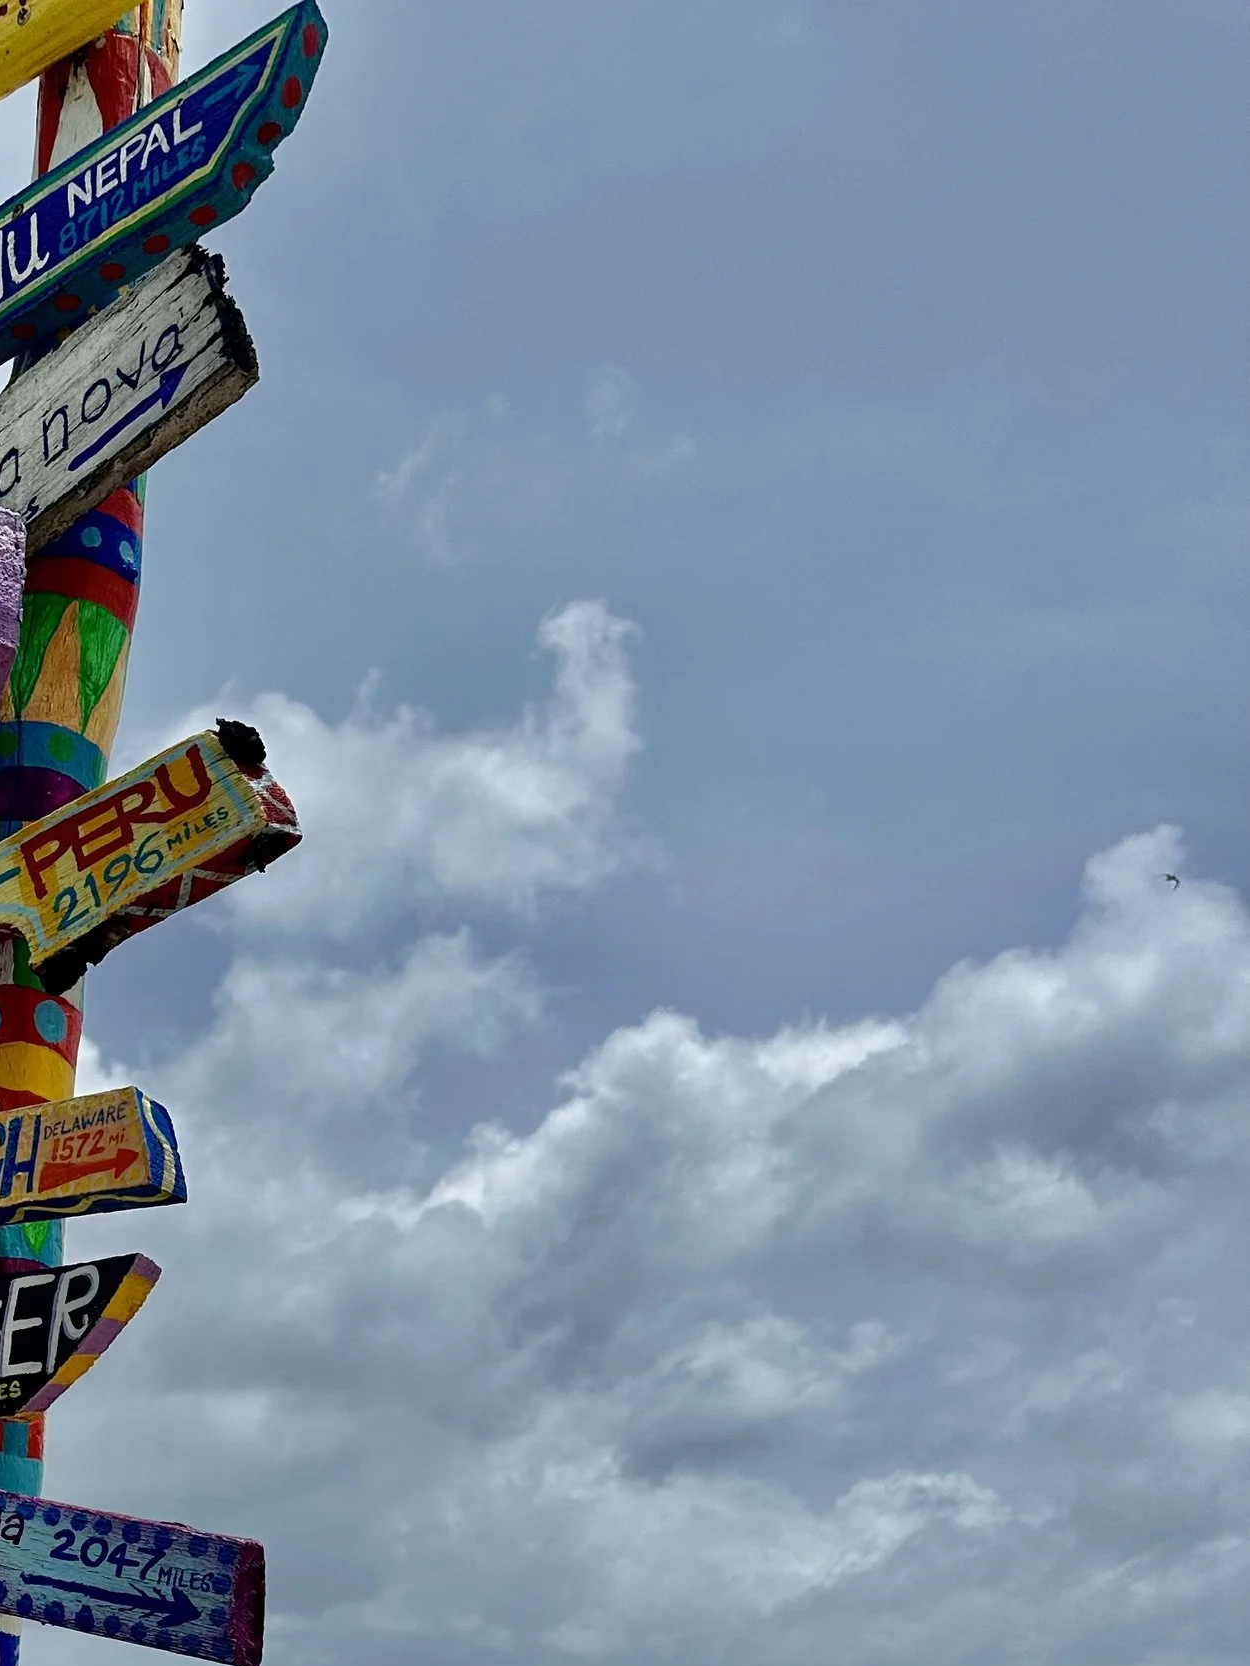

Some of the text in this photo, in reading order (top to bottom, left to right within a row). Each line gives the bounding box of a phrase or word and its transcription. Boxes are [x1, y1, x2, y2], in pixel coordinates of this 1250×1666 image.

[58, 134, 207, 255] 8712 MILES
[67, 108, 203, 218] NEPAL
[20, 743, 214, 900] PERU
[53, 830, 163, 931] 2196
[44, 1101, 127, 1140] DELAWARE
[52, 1129, 105, 1161] 1572
[50, 1528, 215, 1593] 2047 MILES
